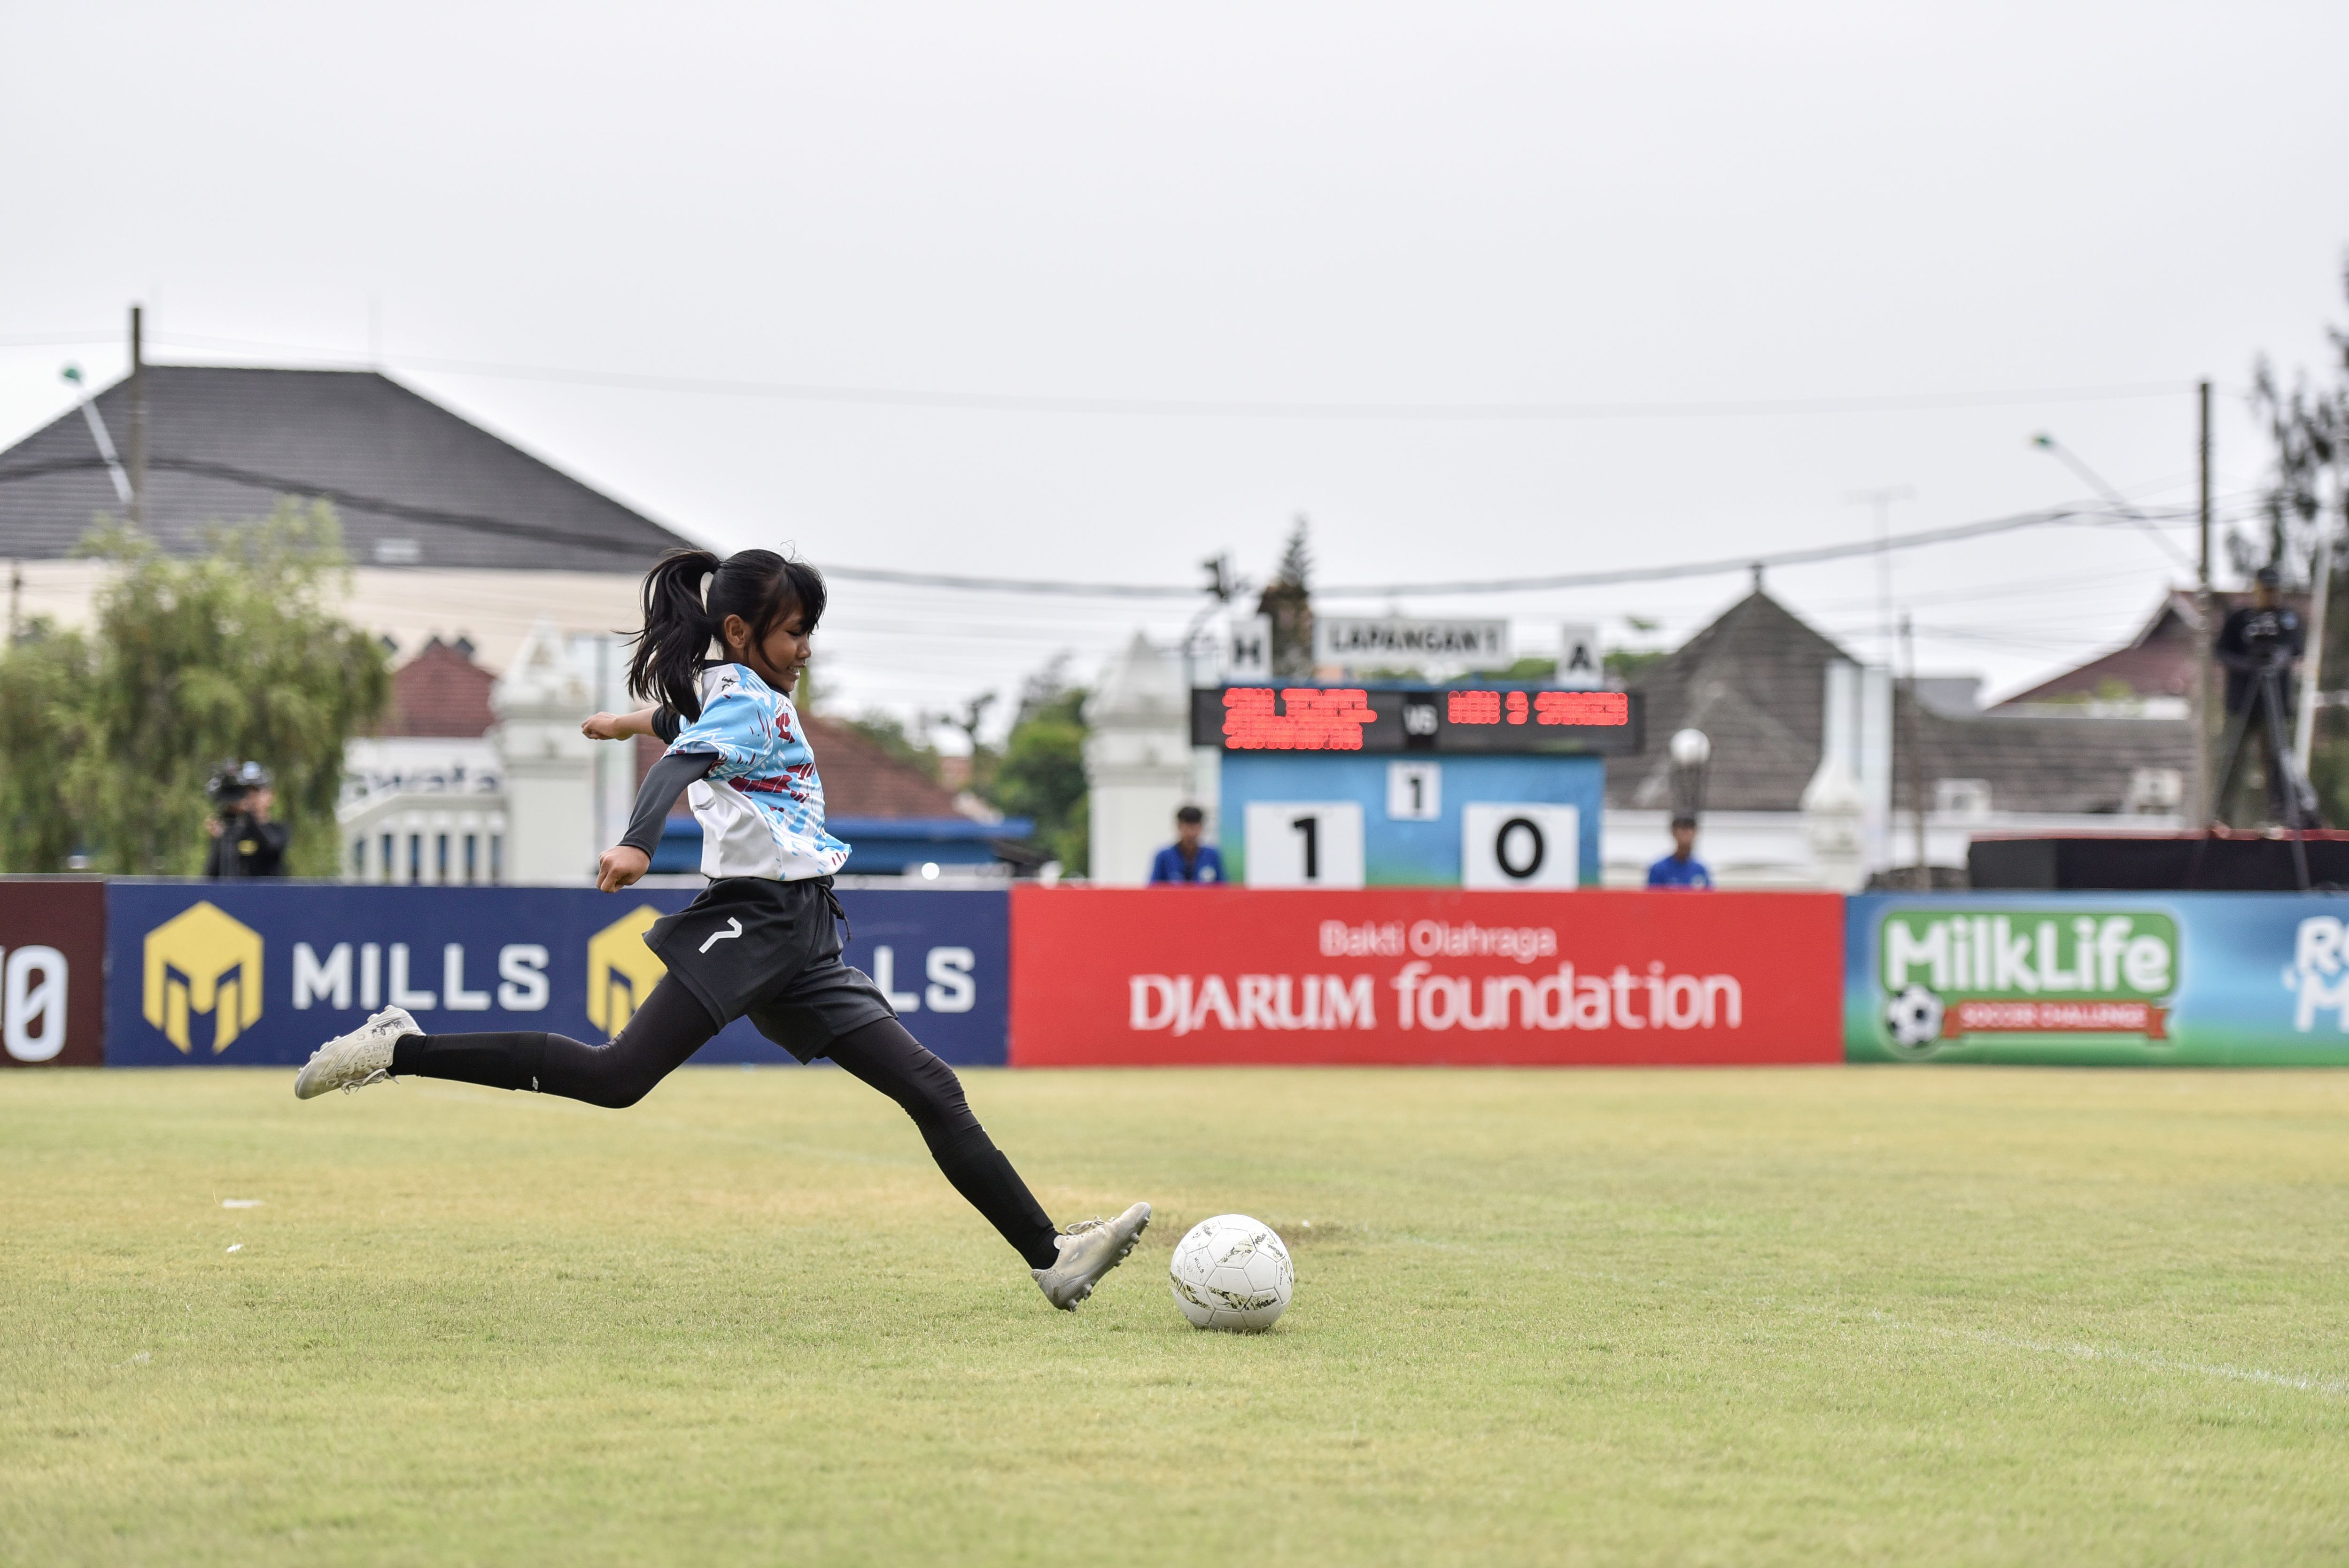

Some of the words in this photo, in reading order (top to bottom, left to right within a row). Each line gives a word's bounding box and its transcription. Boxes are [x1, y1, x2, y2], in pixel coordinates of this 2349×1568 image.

[1234, 636, 1262, 666] H
[1329, 624, 1480, 652] LAPANGAN
[1569, 642, 1592, 670] A
[1409, 777, 1422, 812] 1
[1293, 817, 1318, 879] 1
[1496, 817, 1544, 879] 0
[698, 916, 743, 954] 7
[1319, 919, 1405, 957] Bakti
[1409, 919, 1558, 964] Olahraga
[1885, 915, 2171, 993] MilkLife
[2295, 915, 2349, 977] R
[292, 942, 550, 1011] MILLS
[1129, 974, 1376, 1037] DJARUM
[1390, 960, 1743, 1032] foundation
[1194, 1256, 1205, 1274] MILLS
